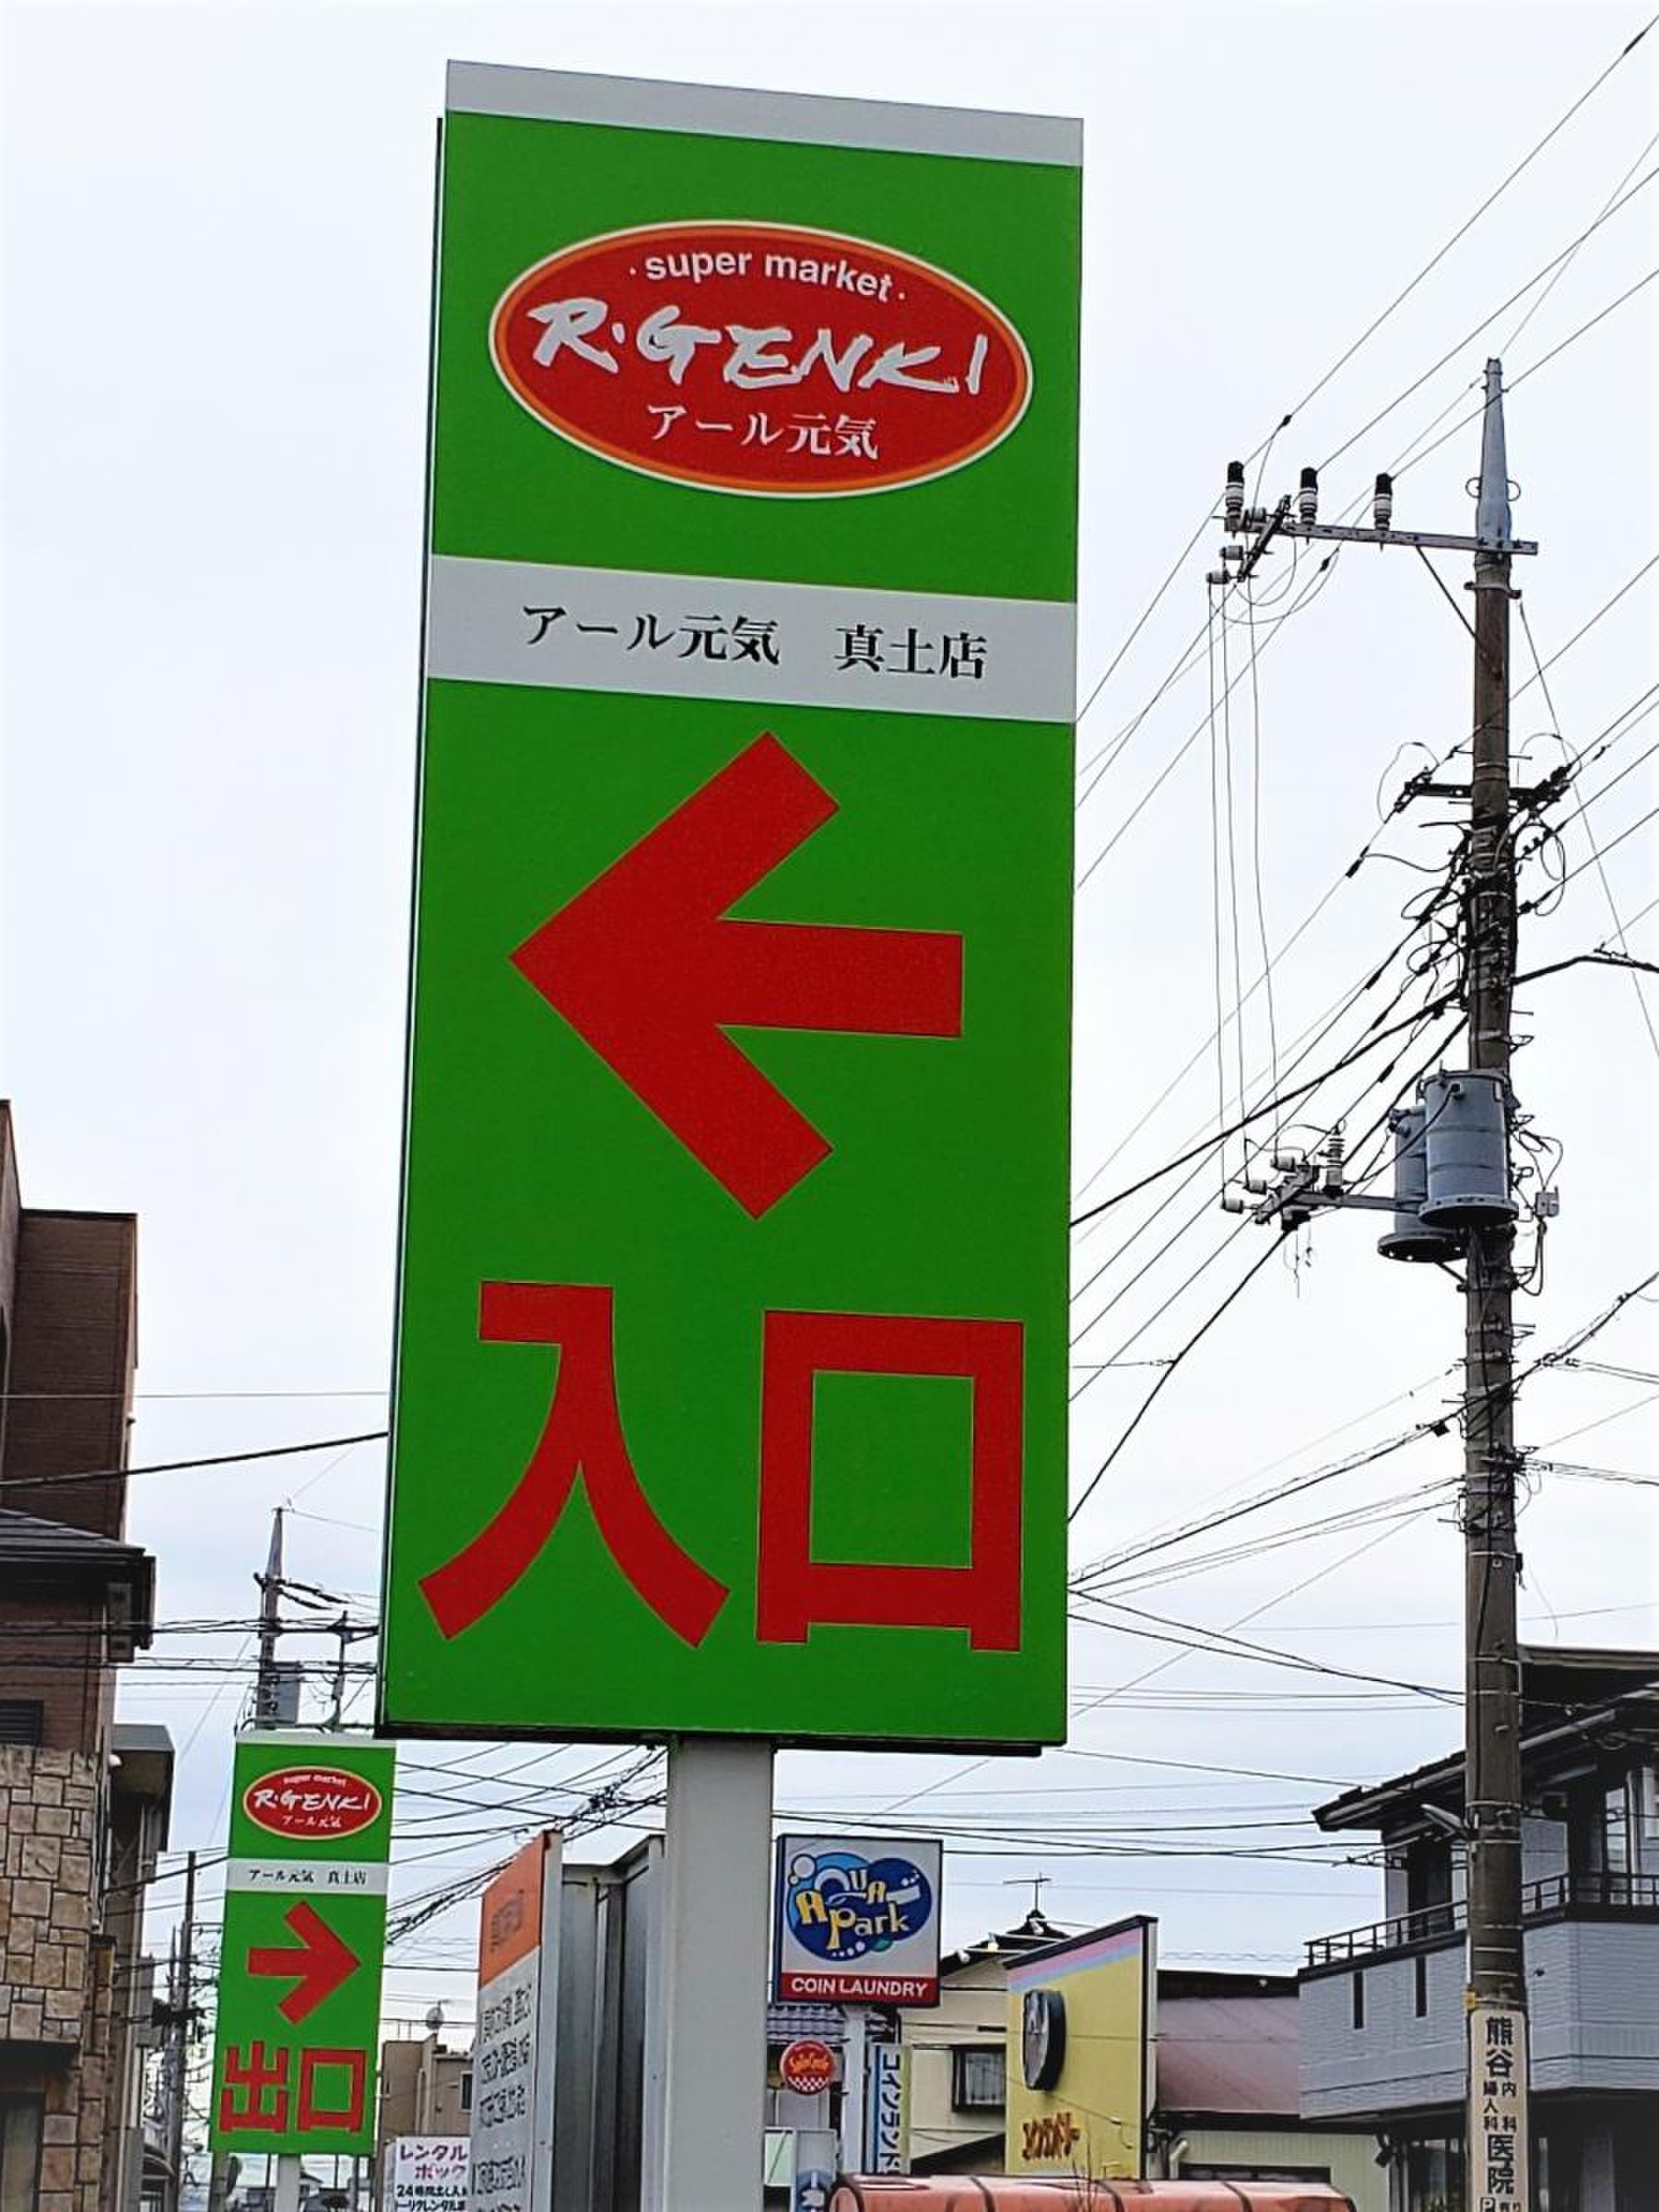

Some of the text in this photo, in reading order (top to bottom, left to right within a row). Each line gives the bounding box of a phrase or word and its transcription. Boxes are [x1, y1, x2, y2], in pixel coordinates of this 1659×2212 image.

[645, 249, 893, 302] super market
[647, 404, 878, 461] アール元気
[523, 605, 987, 680] アール元気 真土店
[418, 1280, 1024, 1653] 入口
[791, 1977, 928, 1997] COIN LAUNDRY
[219, 2040, 367, 2134] 出口
[400, 2144, 468, 2161] レンタル
[1487, 2134, 1515, 2194] 医院
